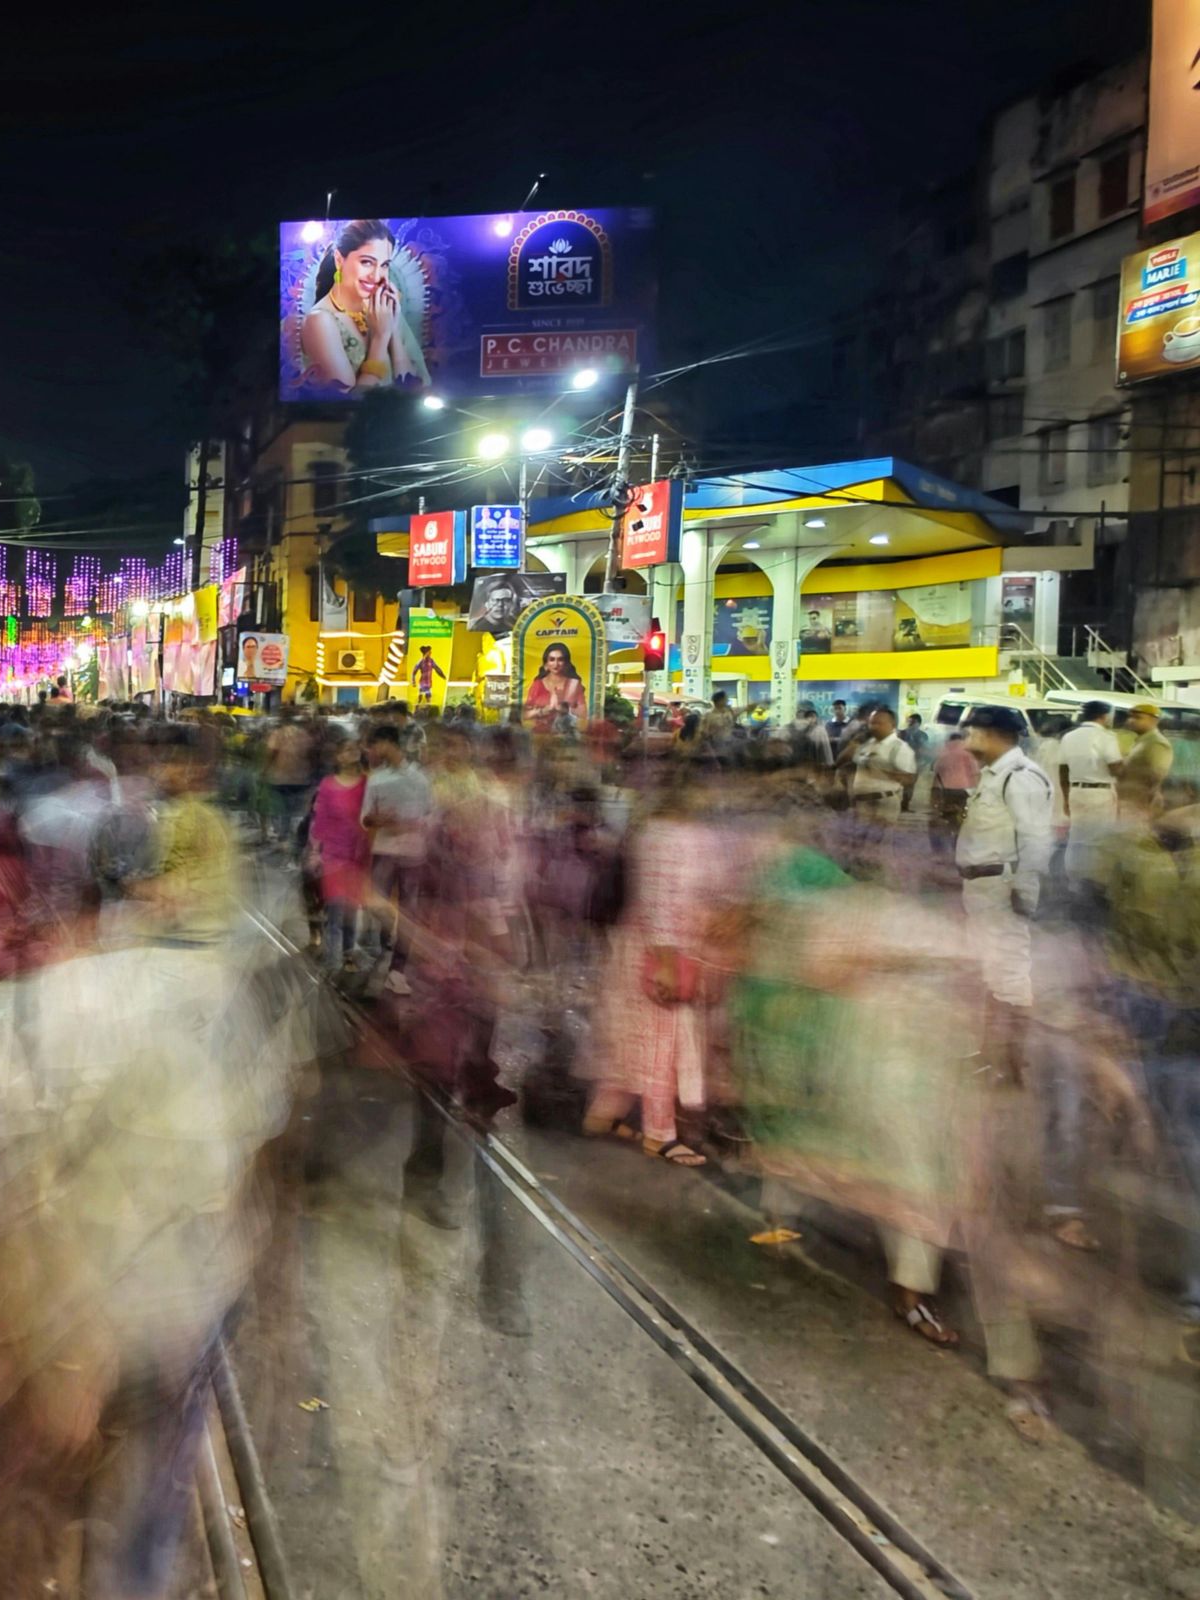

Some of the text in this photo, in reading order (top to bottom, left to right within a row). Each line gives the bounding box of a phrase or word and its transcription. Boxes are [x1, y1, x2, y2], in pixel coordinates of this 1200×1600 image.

[1146, 263, 1181, 285] MARIE
[533, 335, 629, 352] CHANDRA
[486, 354, 630, 369] JEWELL
[413, 539, 448, 557] SABURI
[412, 555, 447, 566] PLYWOOD
[536, 628, 578, 637] CAPTAIN
